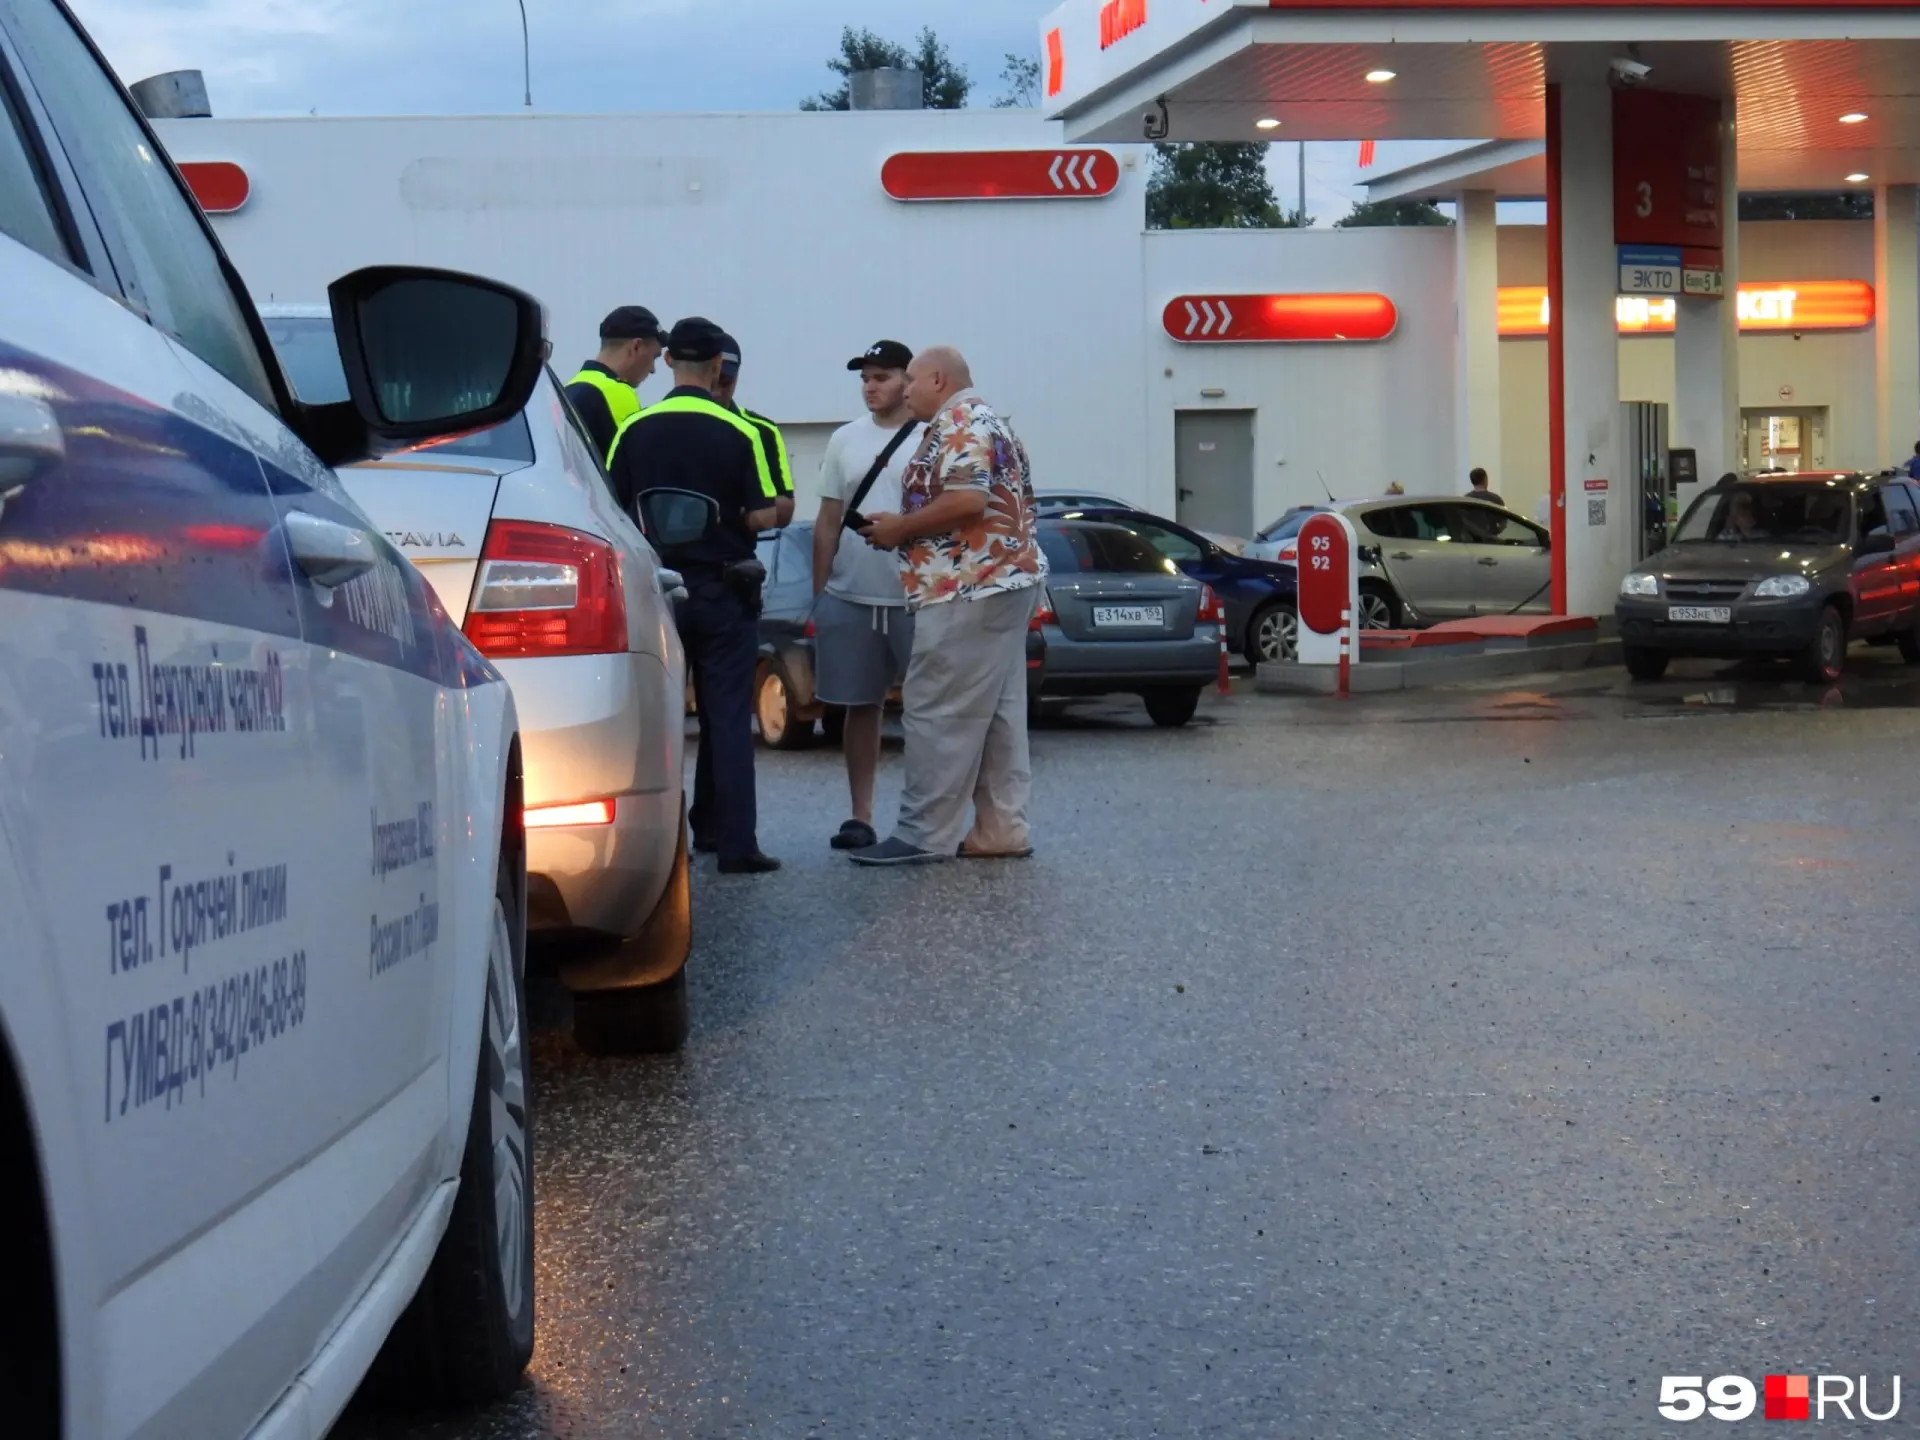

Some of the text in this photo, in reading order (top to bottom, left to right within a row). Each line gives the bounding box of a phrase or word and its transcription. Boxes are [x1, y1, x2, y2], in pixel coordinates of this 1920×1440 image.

[1636, 181, 1653, 219] 3
[1633, 270, 1673, 289] ЭКТО
[1704, 271, 1711, 292] 5
[1311, 536, 1330, 551] 95
[1311, 555, 1330, 570] 92
[106, 895, 154, 976] тел.
[159, 849, 238, 976] Горячей
